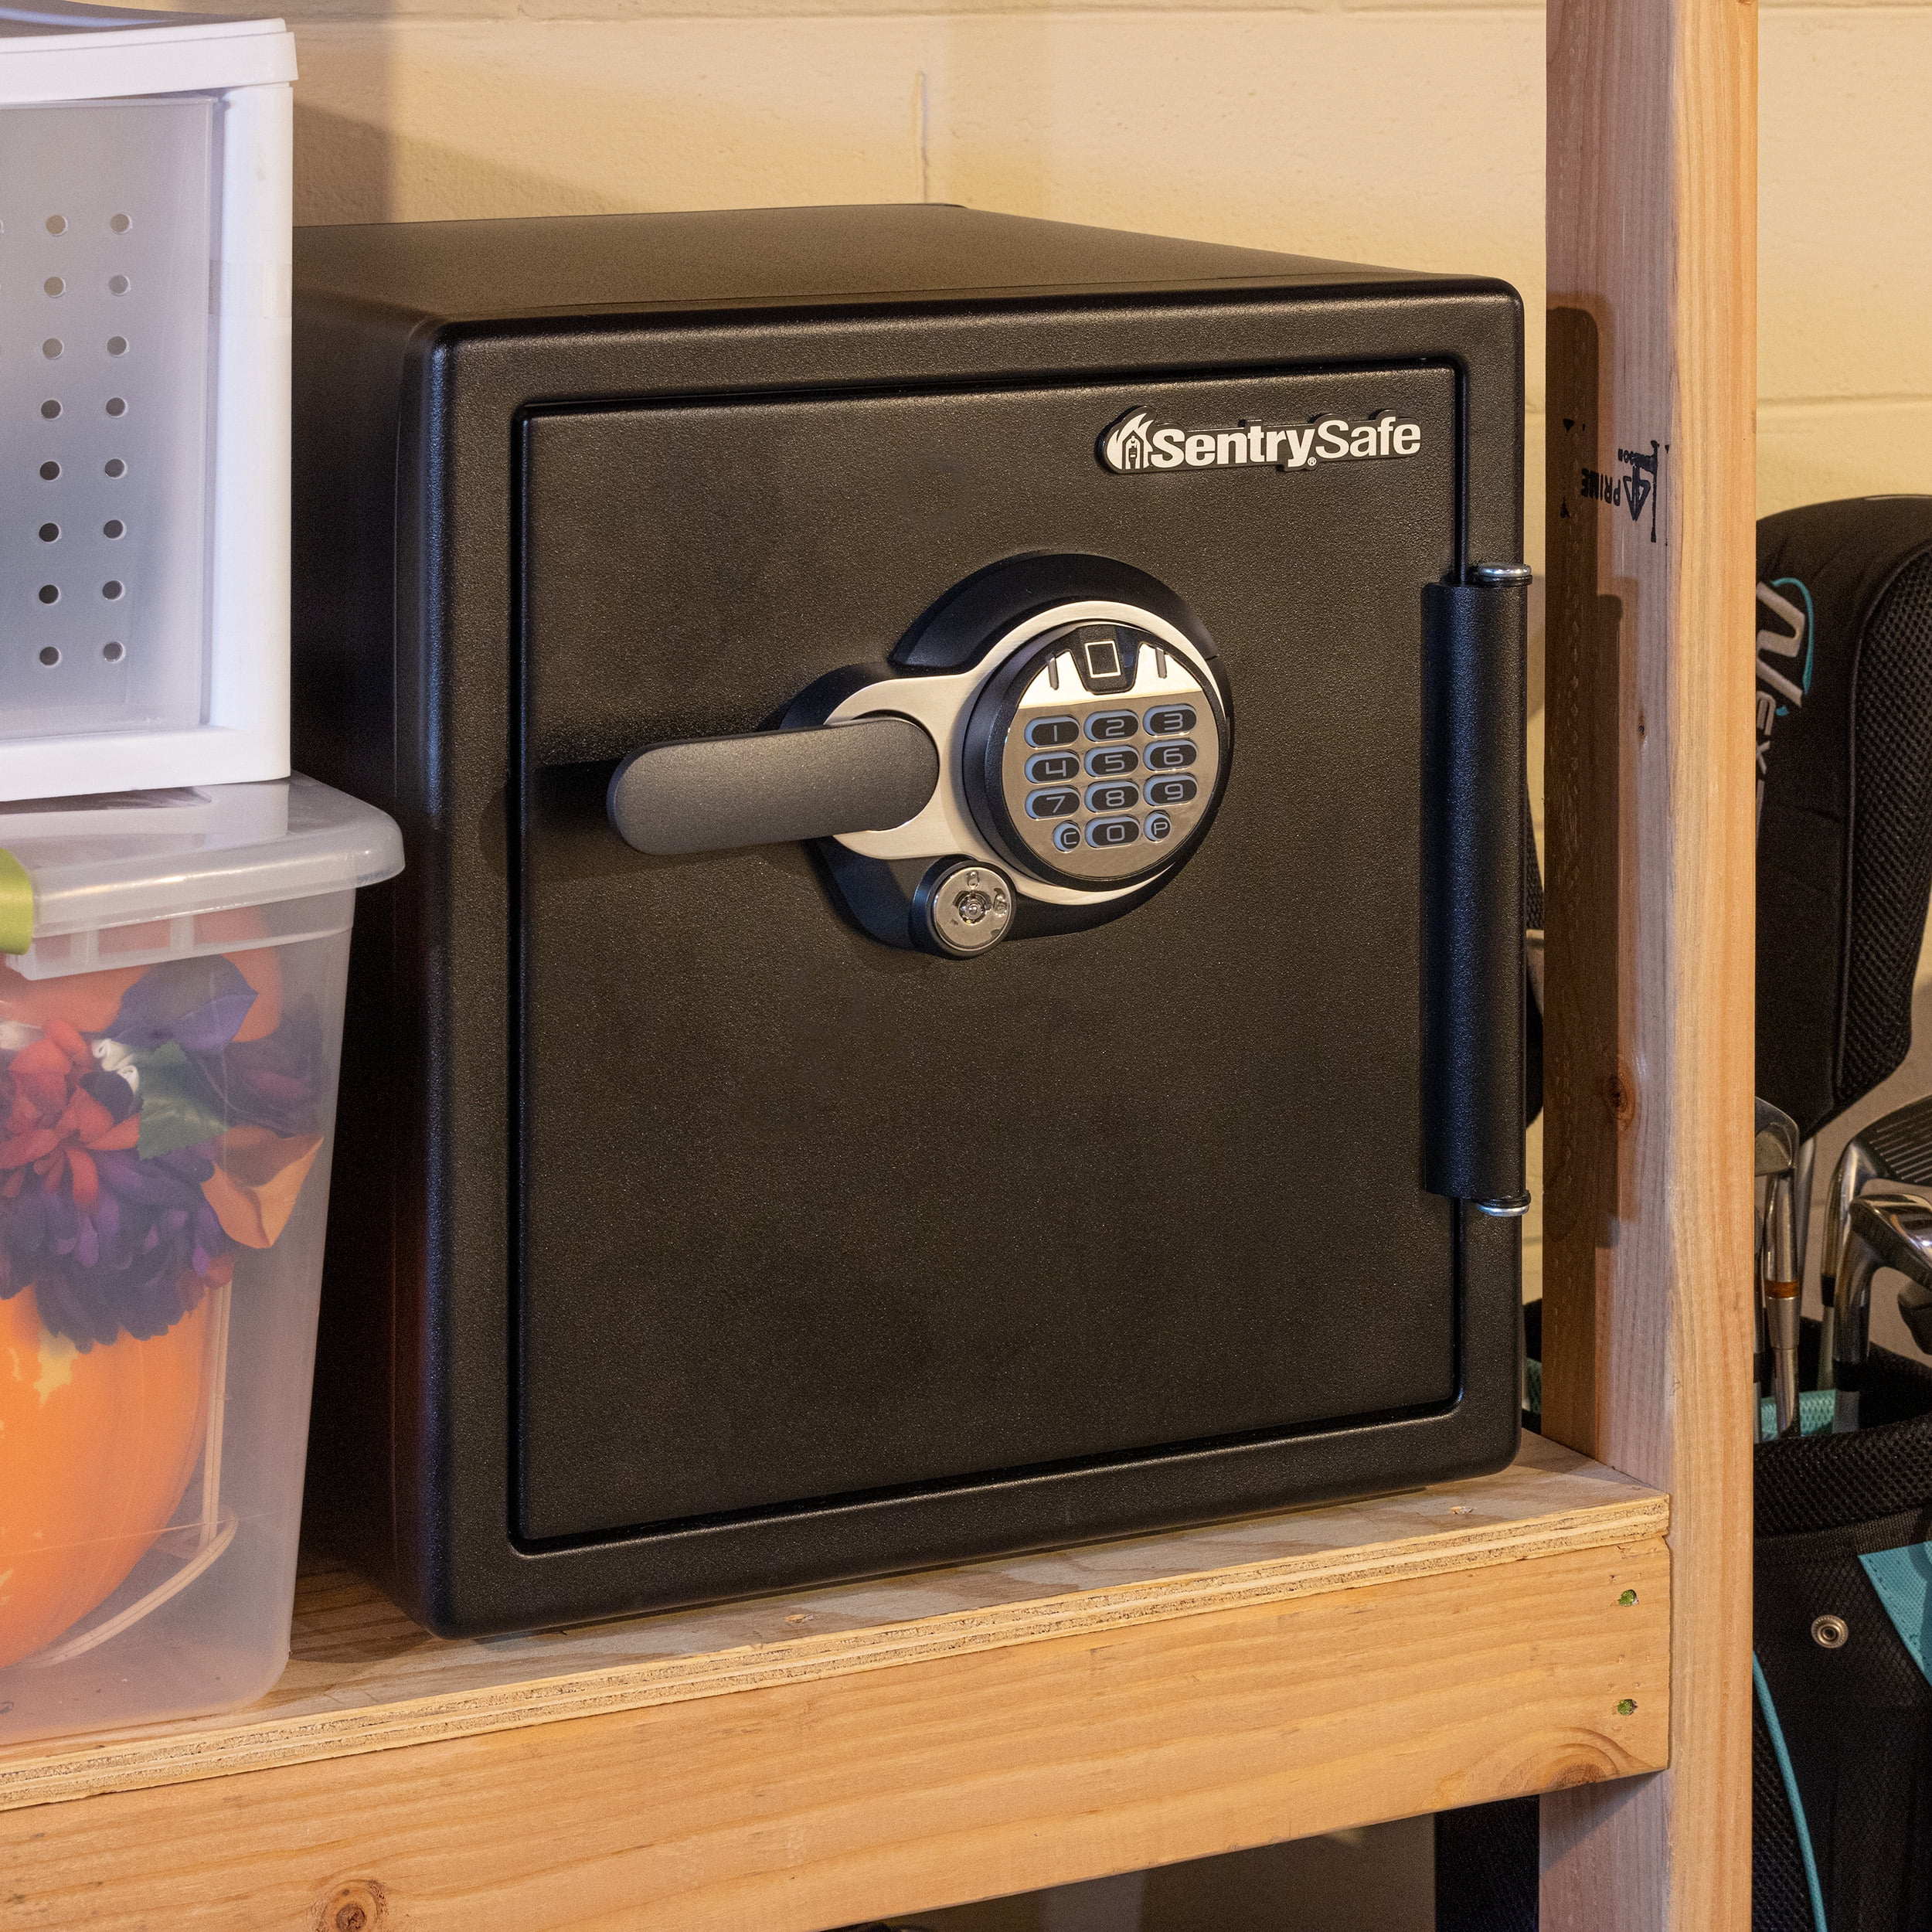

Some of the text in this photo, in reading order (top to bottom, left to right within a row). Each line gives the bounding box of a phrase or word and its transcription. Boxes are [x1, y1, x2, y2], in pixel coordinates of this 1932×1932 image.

[1151, 416, 1421, 468] SentrySafe
[1581, 468, 1621, 506] PRIME
[1106, 719, 1124, 736] 2
[1164, 713, 1183, 730] 3
[1046, 748, 1183, 776] 4 5 6
[1046, 784, 1183, 813] 7 8 9
[1154, 821, 1168, 835] P
